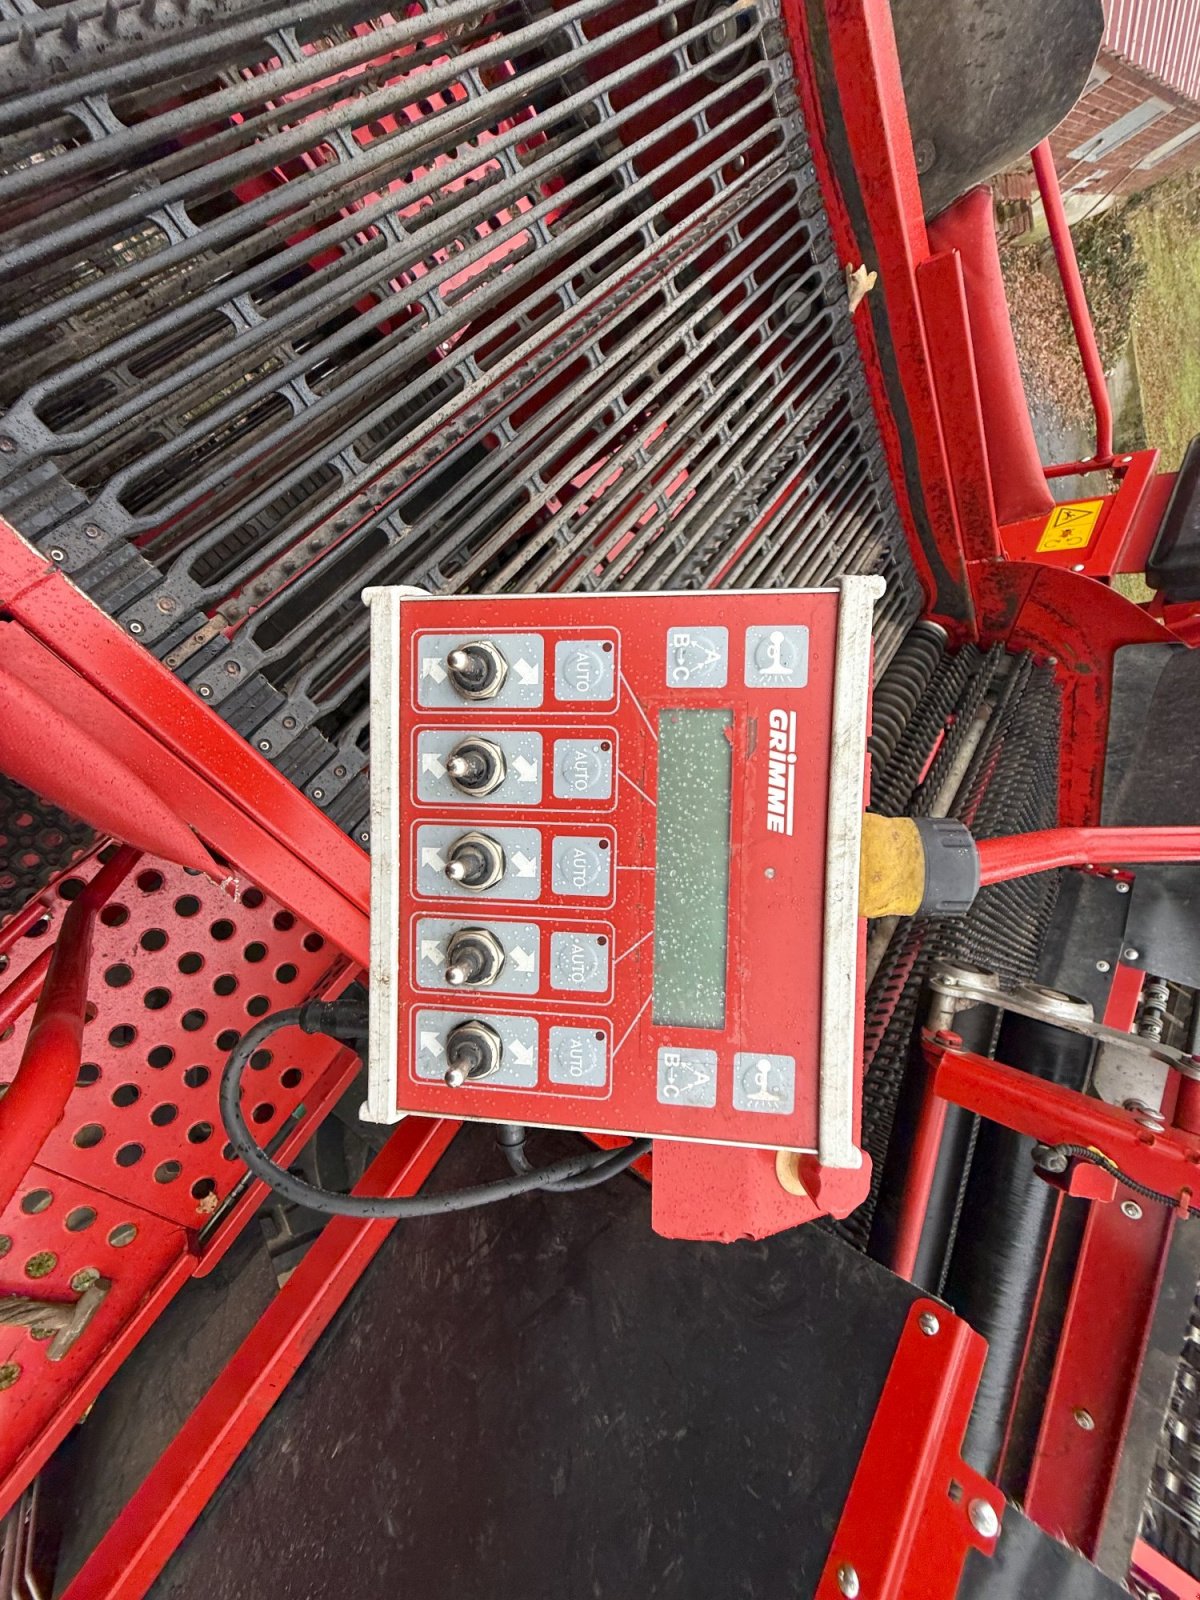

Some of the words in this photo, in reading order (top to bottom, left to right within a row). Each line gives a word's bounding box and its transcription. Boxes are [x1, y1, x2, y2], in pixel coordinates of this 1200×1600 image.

[673, 633, 690, 648] B
[704, 647, 722, 665] A
[576, 651, 591, 693] AUTO
[672, 666, 690, 682] C
[574, 750, 589, 792] AUTO
[572, 847, 587, 888] AUTO
[571, 943, 585, 983] AUTO
[570, 1038, 583, 1078] AUTO
[664, 1052, 681, 1068] B
[693, 1069, 711, 1087] A
[663, 1083, 680, 1099] C
